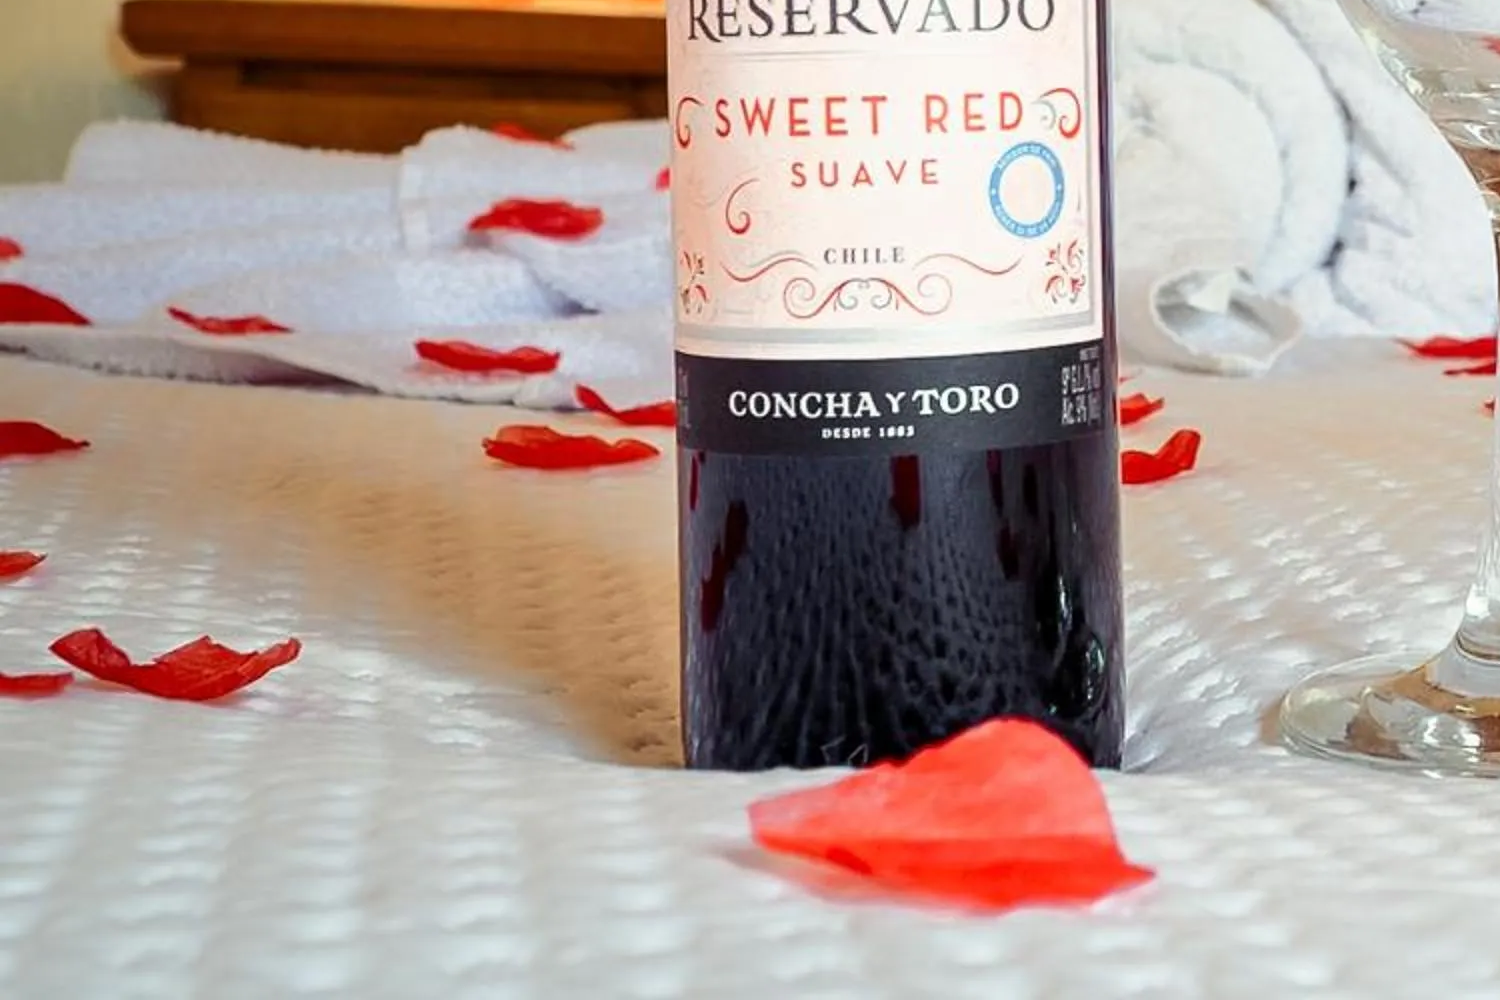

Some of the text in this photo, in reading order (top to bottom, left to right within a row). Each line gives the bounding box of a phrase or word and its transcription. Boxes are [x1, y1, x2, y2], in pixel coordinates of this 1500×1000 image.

[715, 92, 1023, 137] SWEET RED
[791, 159, 939, 188] SUAVE
[823, 247, 905, 265] CHILE
[729, 383, 1019, 418] CONCHA Y TORO
[821, 427, 871, 439] DESDE
